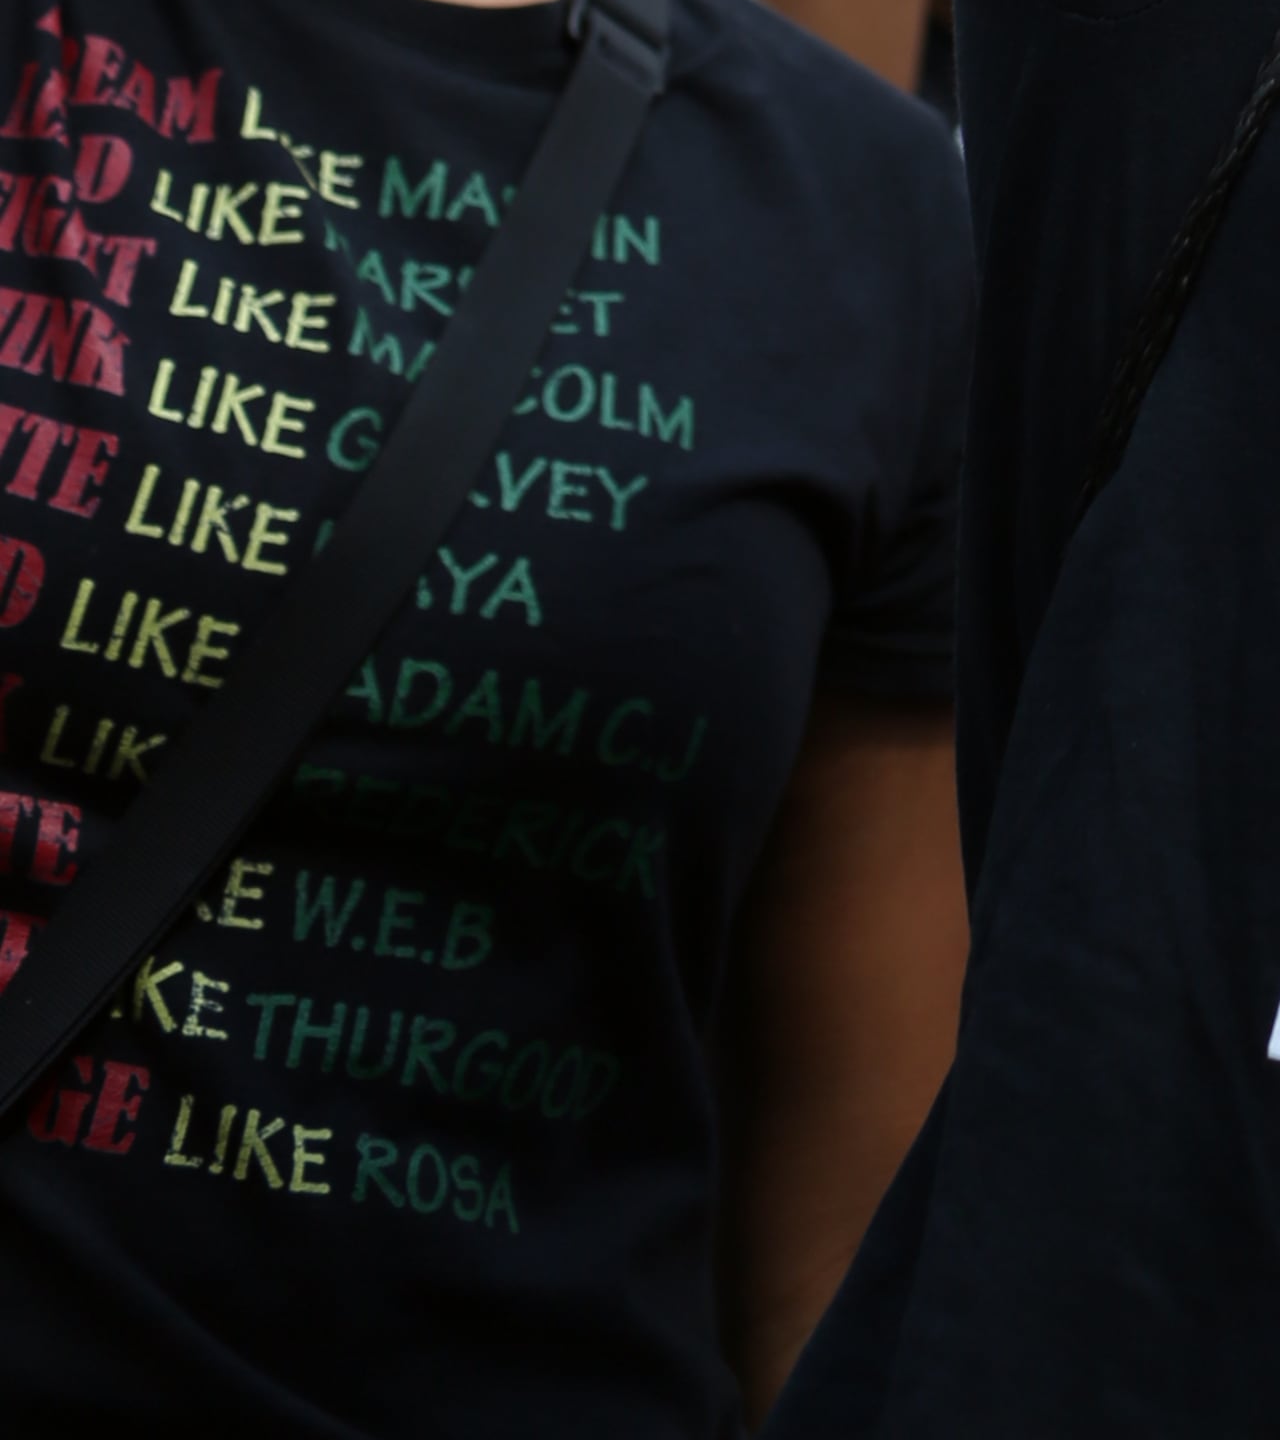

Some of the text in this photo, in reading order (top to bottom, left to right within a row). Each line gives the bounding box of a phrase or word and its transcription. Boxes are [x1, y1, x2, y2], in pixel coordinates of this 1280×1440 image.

[34, 5, 662, 266] EAM LE MAIN
[150, 168, 310, 246] LIKE
[0, 286, 648, 532] INK LIKE GVEY
[168, 258, 336, 353] LIKE
[348, 307, 698, 452] MOLM
[124, 463, 300, 576] LIKE
[59, 578, 242, 690] LIKE
[345, 656, 588, 758] ADAM
[39, 702, 168, 786] LIK
[292, 760, 670, 902] REDERICK
[112, 955, 231, 1043] KE
[163, 1094, 333, 1196] LIKE
[350, 1132, 521, 1236] ROSA
